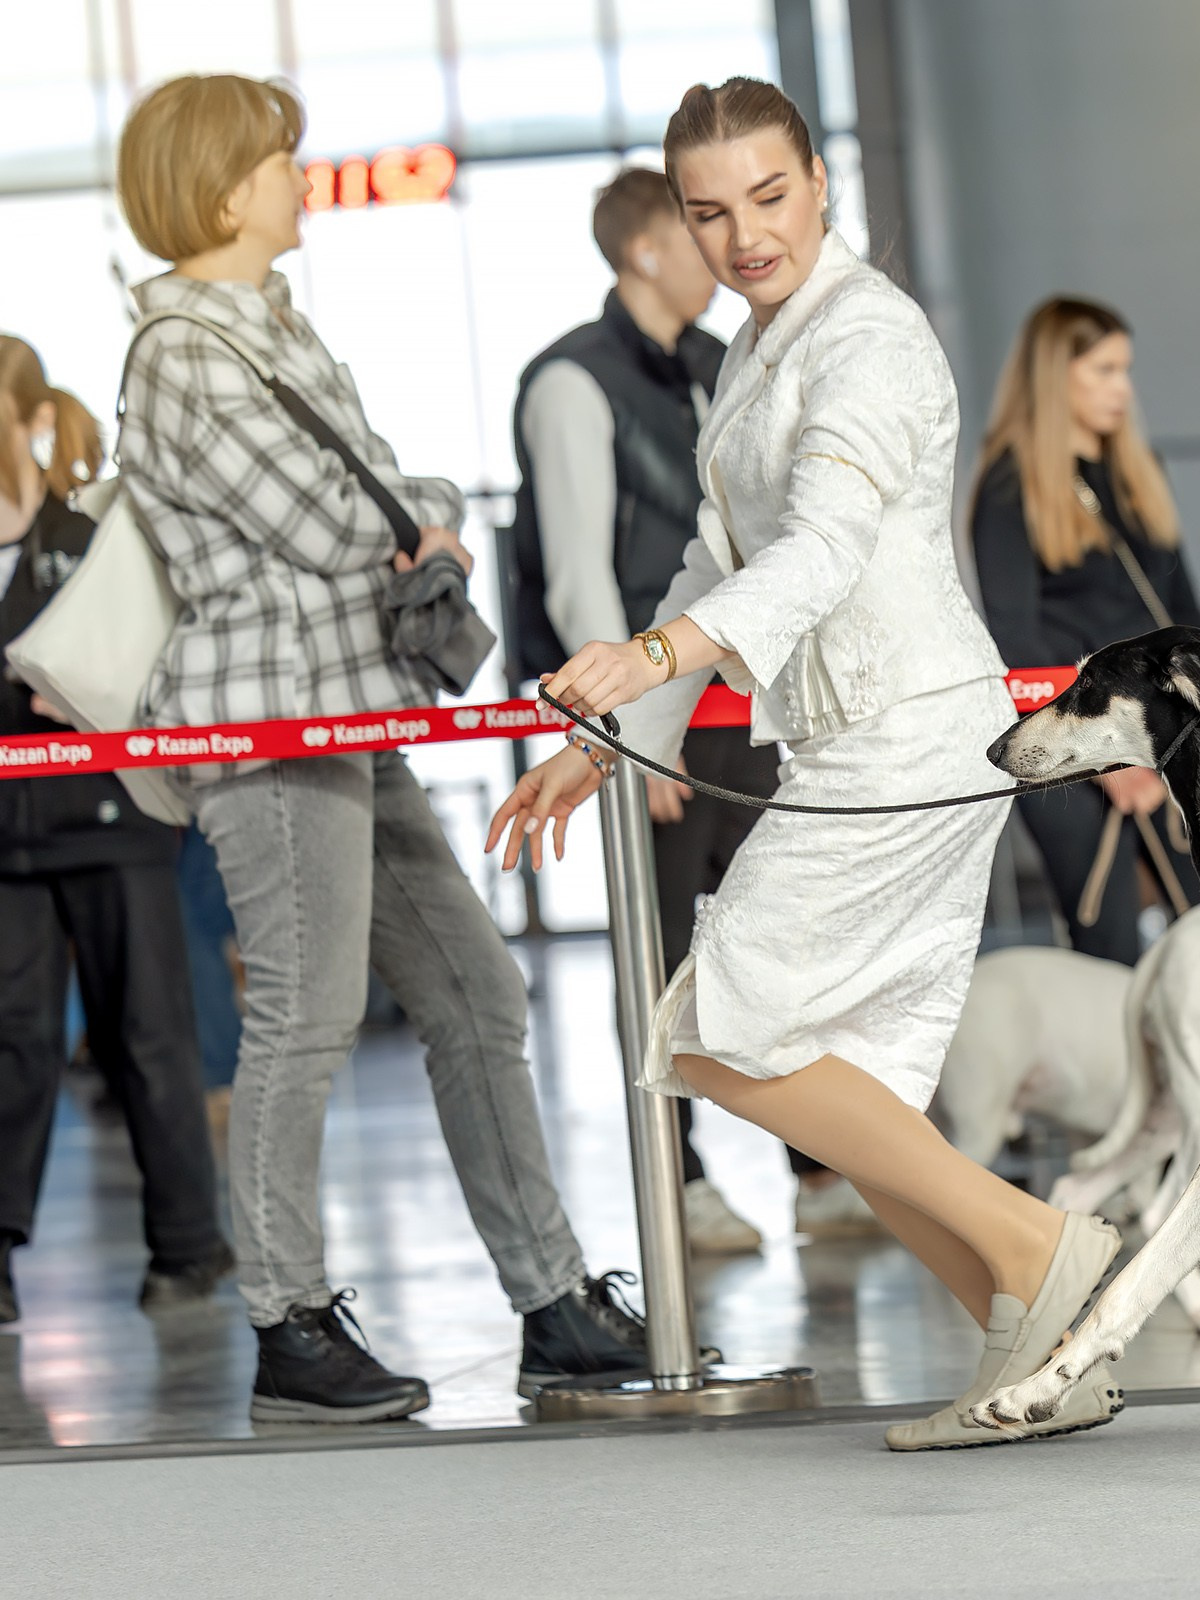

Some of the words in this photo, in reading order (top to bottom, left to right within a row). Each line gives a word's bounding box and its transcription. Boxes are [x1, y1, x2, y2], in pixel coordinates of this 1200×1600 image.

[1009, 679, 1055, 703] Expo
[484, 707, 538, 728] Kazan
[538, 706, 571, 728] Exp
[157, 734, 209, 757] Kazan
[209, 732, 254, 756] Expo
[332, 724, 385, 746] Kazan
[385, 718, 430, 743] Expo
[48, 741, 92, 767] Expo
